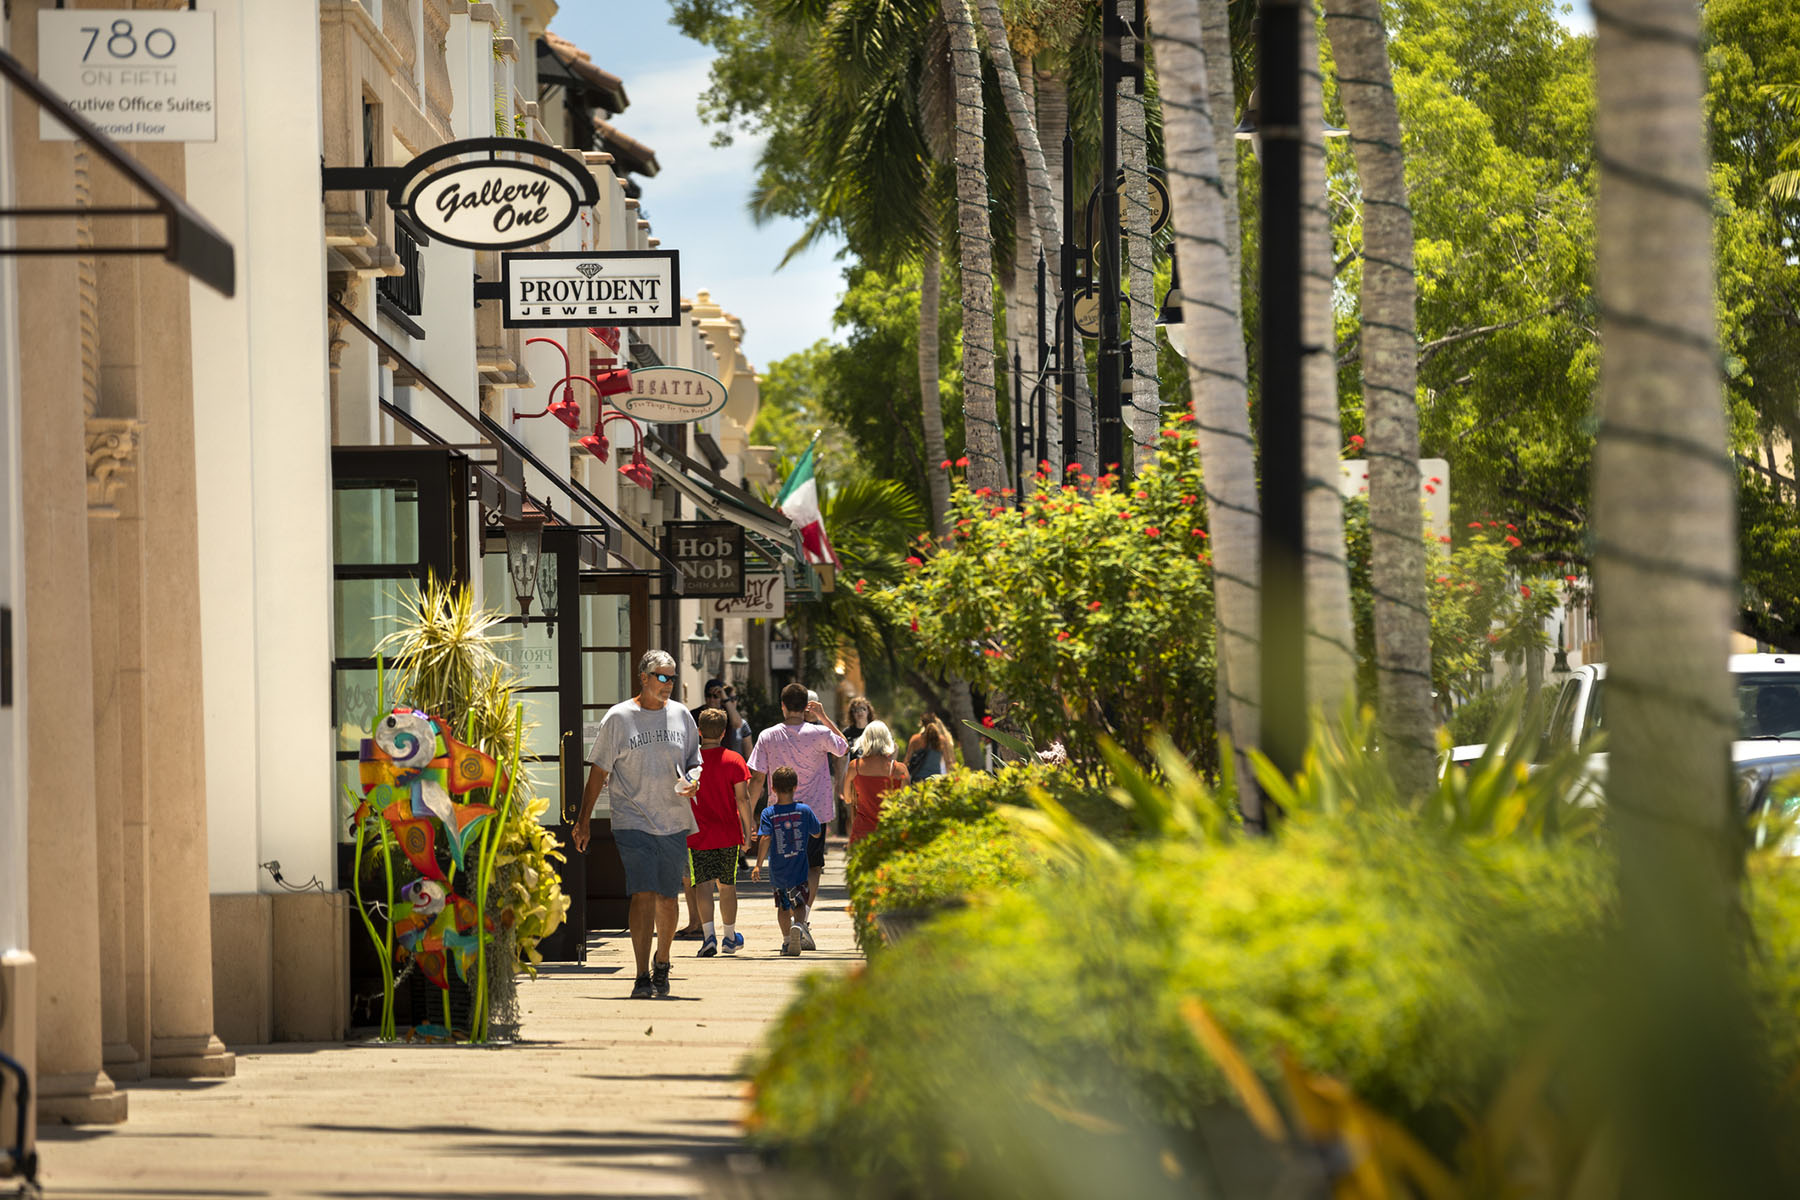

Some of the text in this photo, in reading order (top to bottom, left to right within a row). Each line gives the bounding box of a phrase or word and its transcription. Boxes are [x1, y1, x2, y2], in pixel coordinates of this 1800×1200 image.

[80, 19, 176, 62] 780
[81, 71, 177, 86] ON FIFTH
[66, 97, 212, 112] cutive Office Suites
[136, 122, 166, 134] Floor
[436, 178, 550, 223] Gallery
[493, 203, 549, 233] One
[520, 279, 661, 302] PROVIDENT
[522, 305, 660, 316] JEWELRY
[626, 380, 704, 395] EGATTA
[677, 536, 733, 557] Hob
[678, 559, 733, 580] Nob
